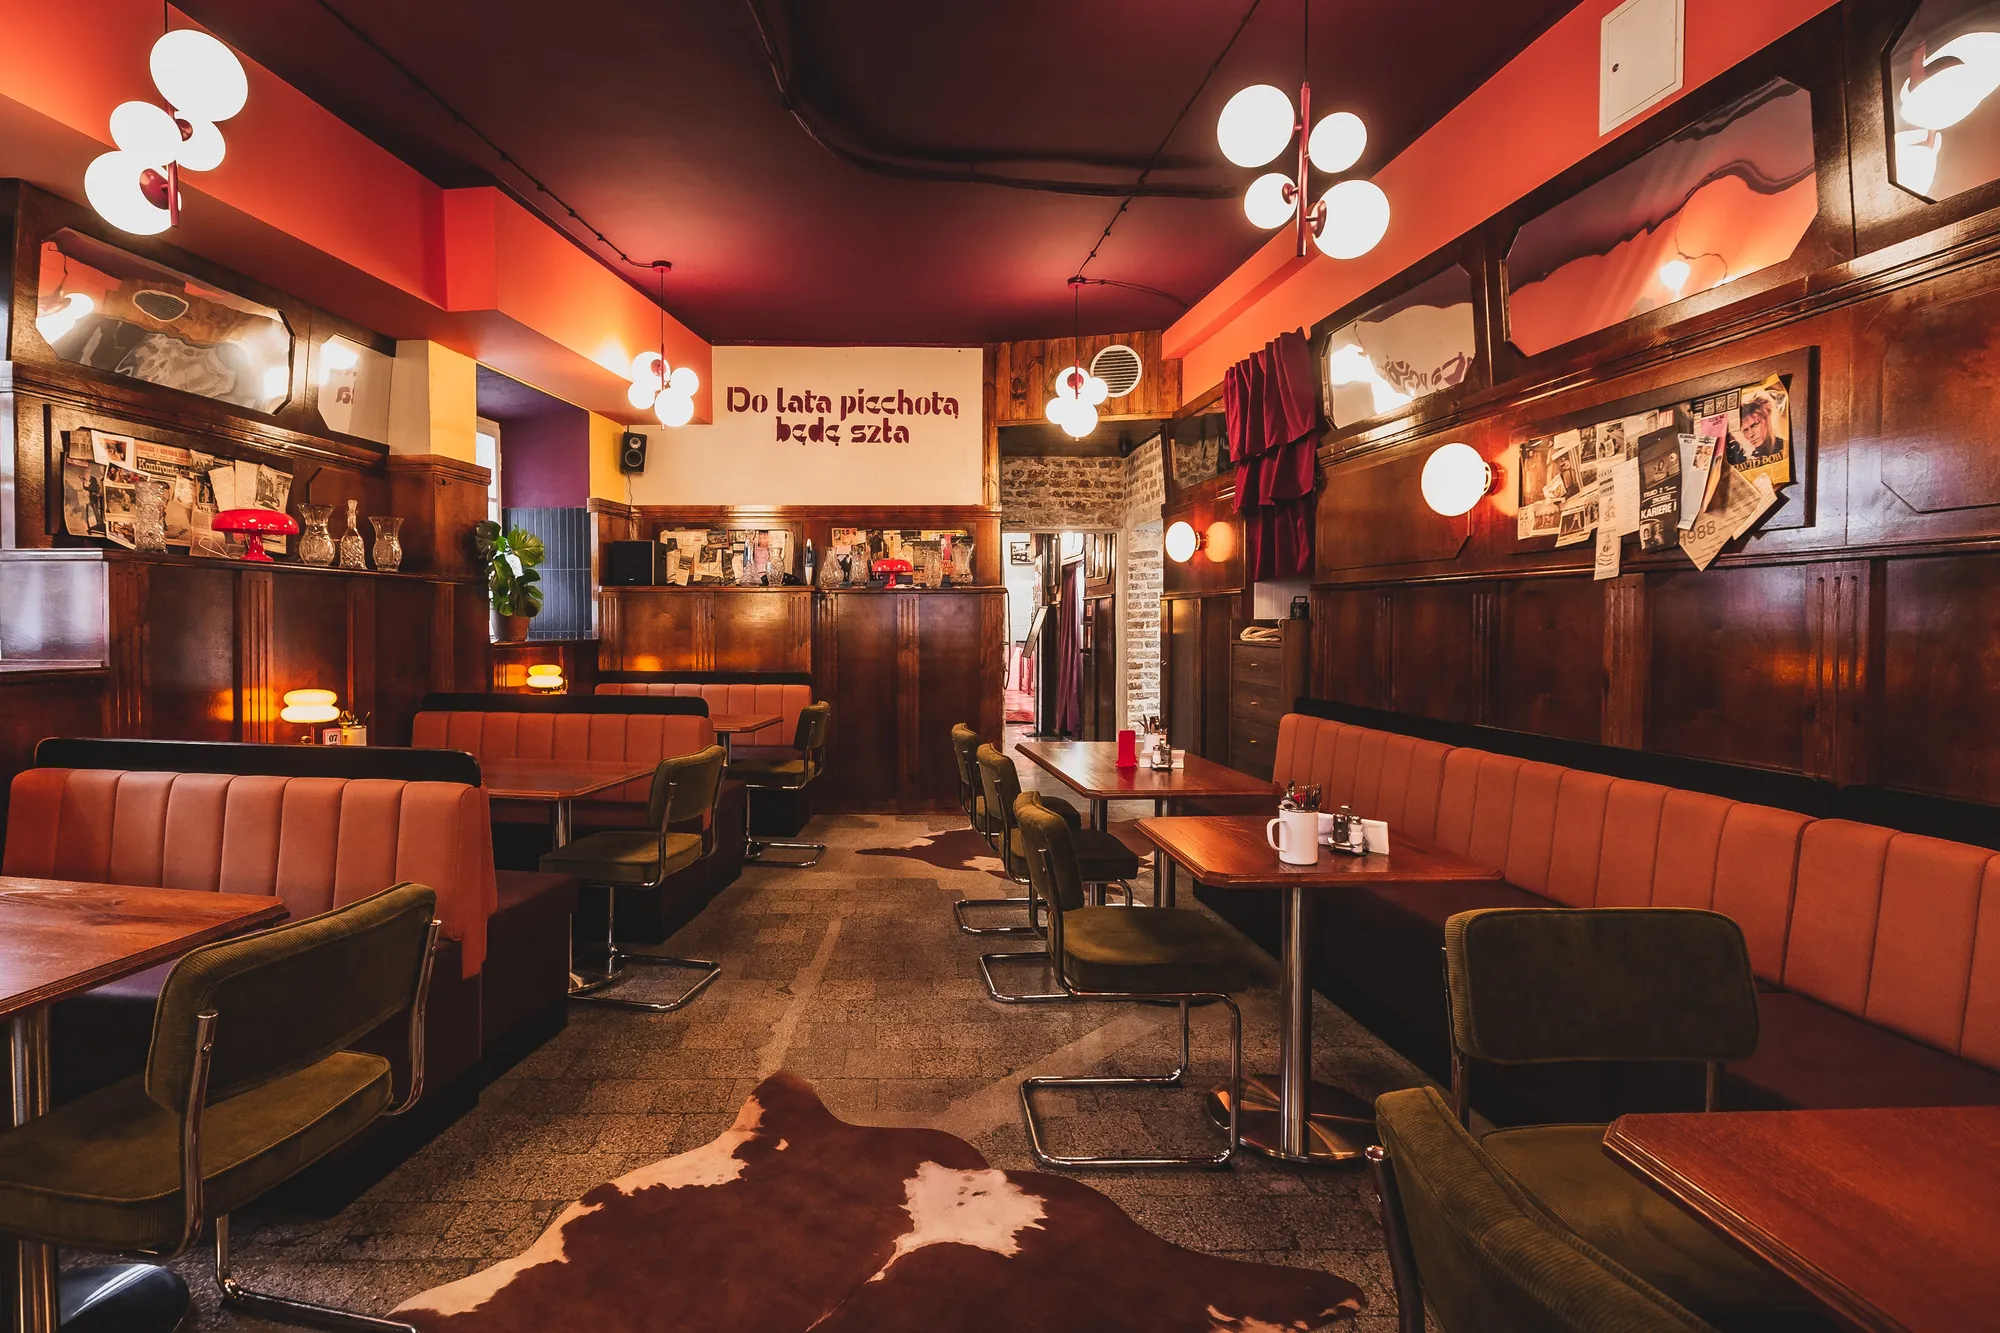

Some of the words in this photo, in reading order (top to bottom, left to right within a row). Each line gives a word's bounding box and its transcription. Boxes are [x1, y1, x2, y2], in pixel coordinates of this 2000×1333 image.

[726, 386, 769, 413] Do
[776, 387, 832, 414] lata
[840, 388, 960, 422] piechotą
[775, 415, 842, 447] będę
[1680, 520, 1717, 547] 1988
